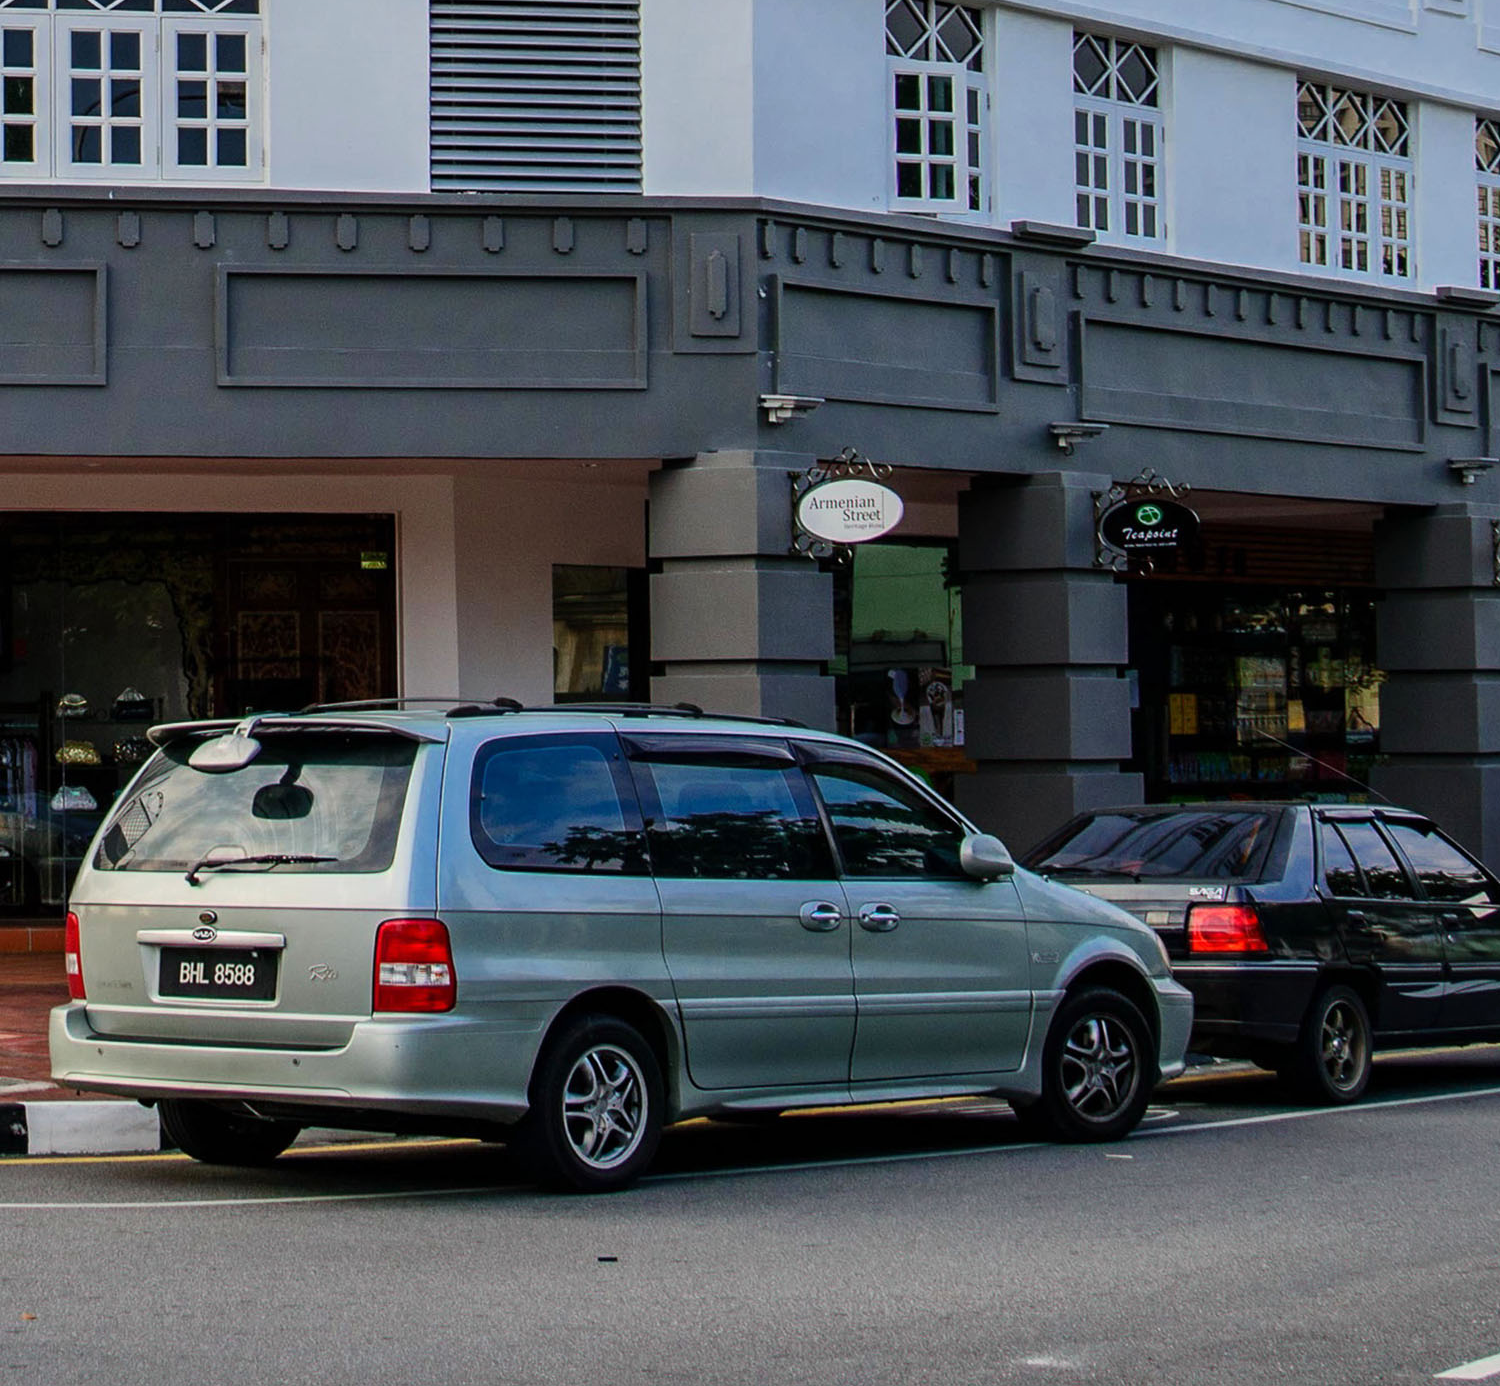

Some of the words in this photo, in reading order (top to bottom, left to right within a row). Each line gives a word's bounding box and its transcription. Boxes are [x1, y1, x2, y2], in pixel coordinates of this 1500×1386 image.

[809, 495, 876, 510] Armenian
[842, 508, 881, 522] Street
[1122, 527, 1178, 541] Teapoint
[179, 961, 209, 984] BHL
[214, 963, 255, 986] 8588
